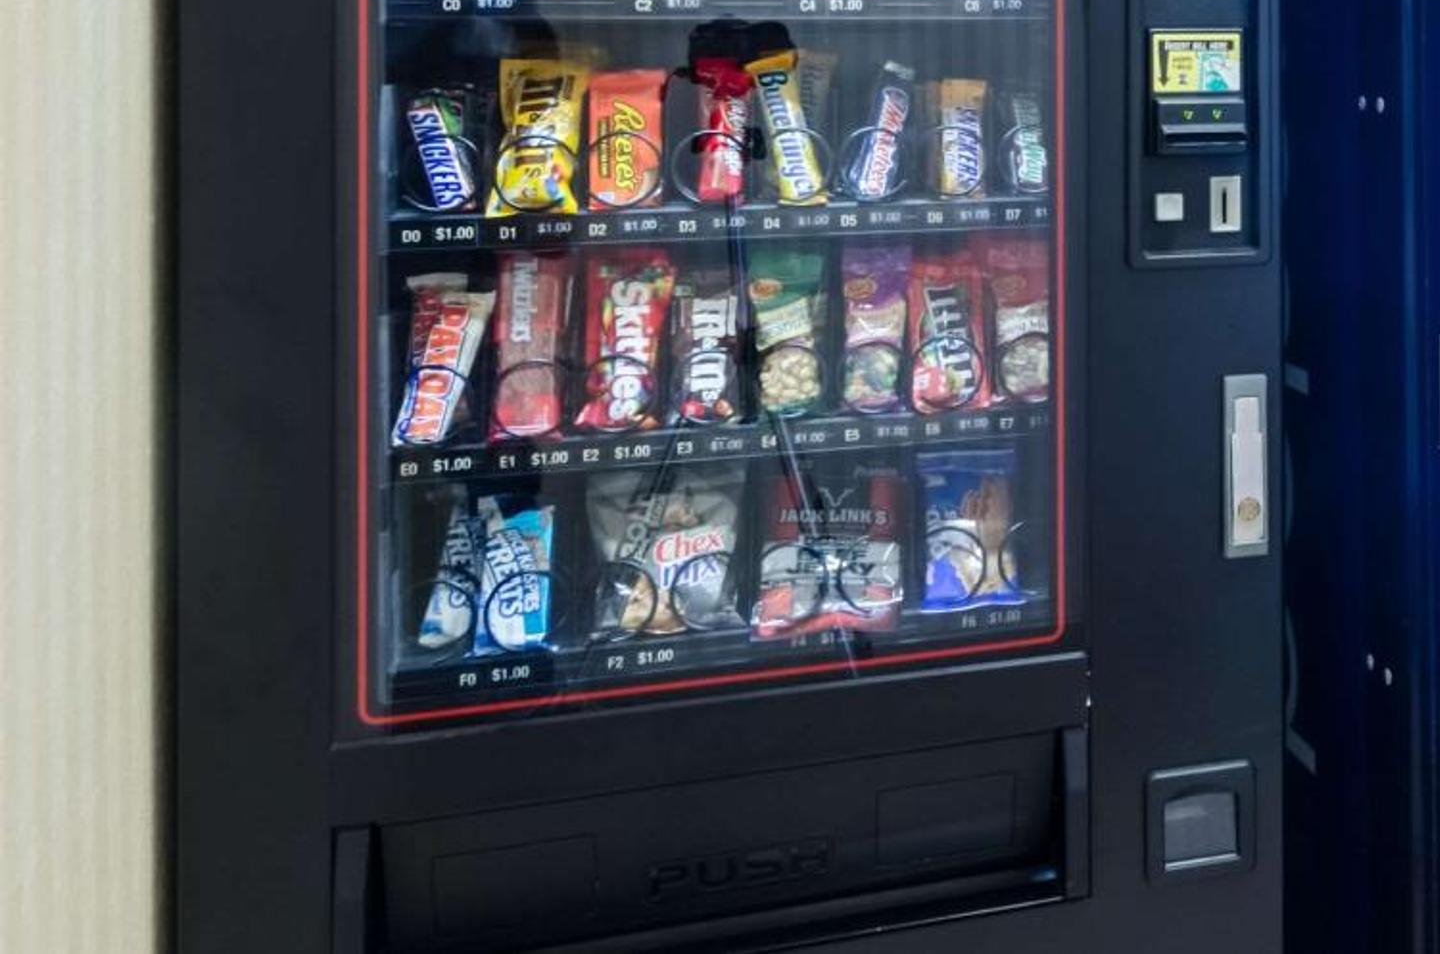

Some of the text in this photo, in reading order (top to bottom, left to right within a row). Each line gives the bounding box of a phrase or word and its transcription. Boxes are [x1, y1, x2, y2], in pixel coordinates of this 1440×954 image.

[993, 0, 1022, 9] $1.00
[411, 112, 466, 209] SNICKERS
[624, 220, 657, 231] $1.00
[799, 215, 829, 226] $1.00
[435, 226, 474, 241] $1.00
[537, 222, 571, 234] $1.00
[795, 432, 825, 442] $1.00
[531, 451, 568, 465] $1.00
[614, 445, 650, 459] $1.00
[433, 457, 472, 472] $1.00
[654, 532, 724, 563] Chex
[638, 649, 674, 664] $1.00
[492, 666, 529, 682] $1.00
